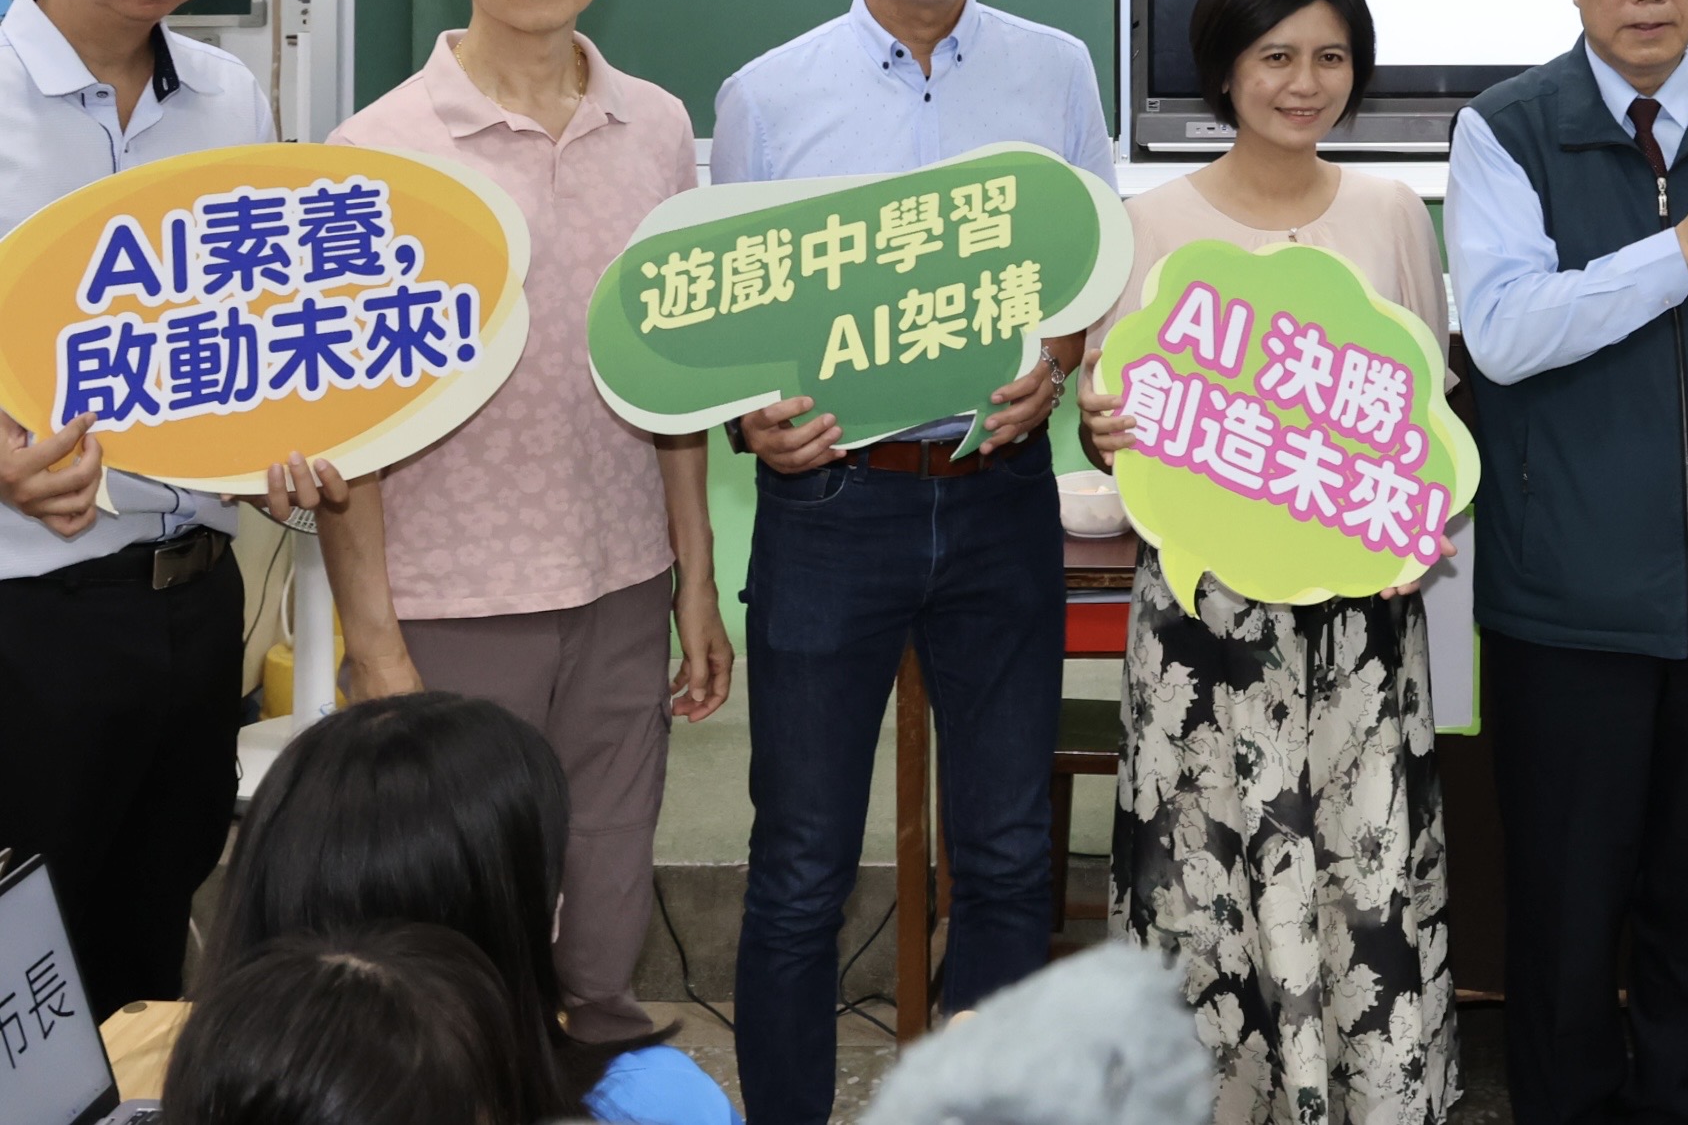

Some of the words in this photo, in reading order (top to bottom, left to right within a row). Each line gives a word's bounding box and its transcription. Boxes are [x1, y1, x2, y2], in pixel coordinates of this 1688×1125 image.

[87, 184, 416, 305] AI素養,
[640, 175, 1018, 334] 遊戲中學習
[61, 285, 475, 426] 啟動未來!
[819, 260, 1044, 380] AI架構
[1164, 286, 1248, 369] AI
[1260, 317, 1424, 464] 決勝,
[1120, 360, 1445, 557] 創造未來!
